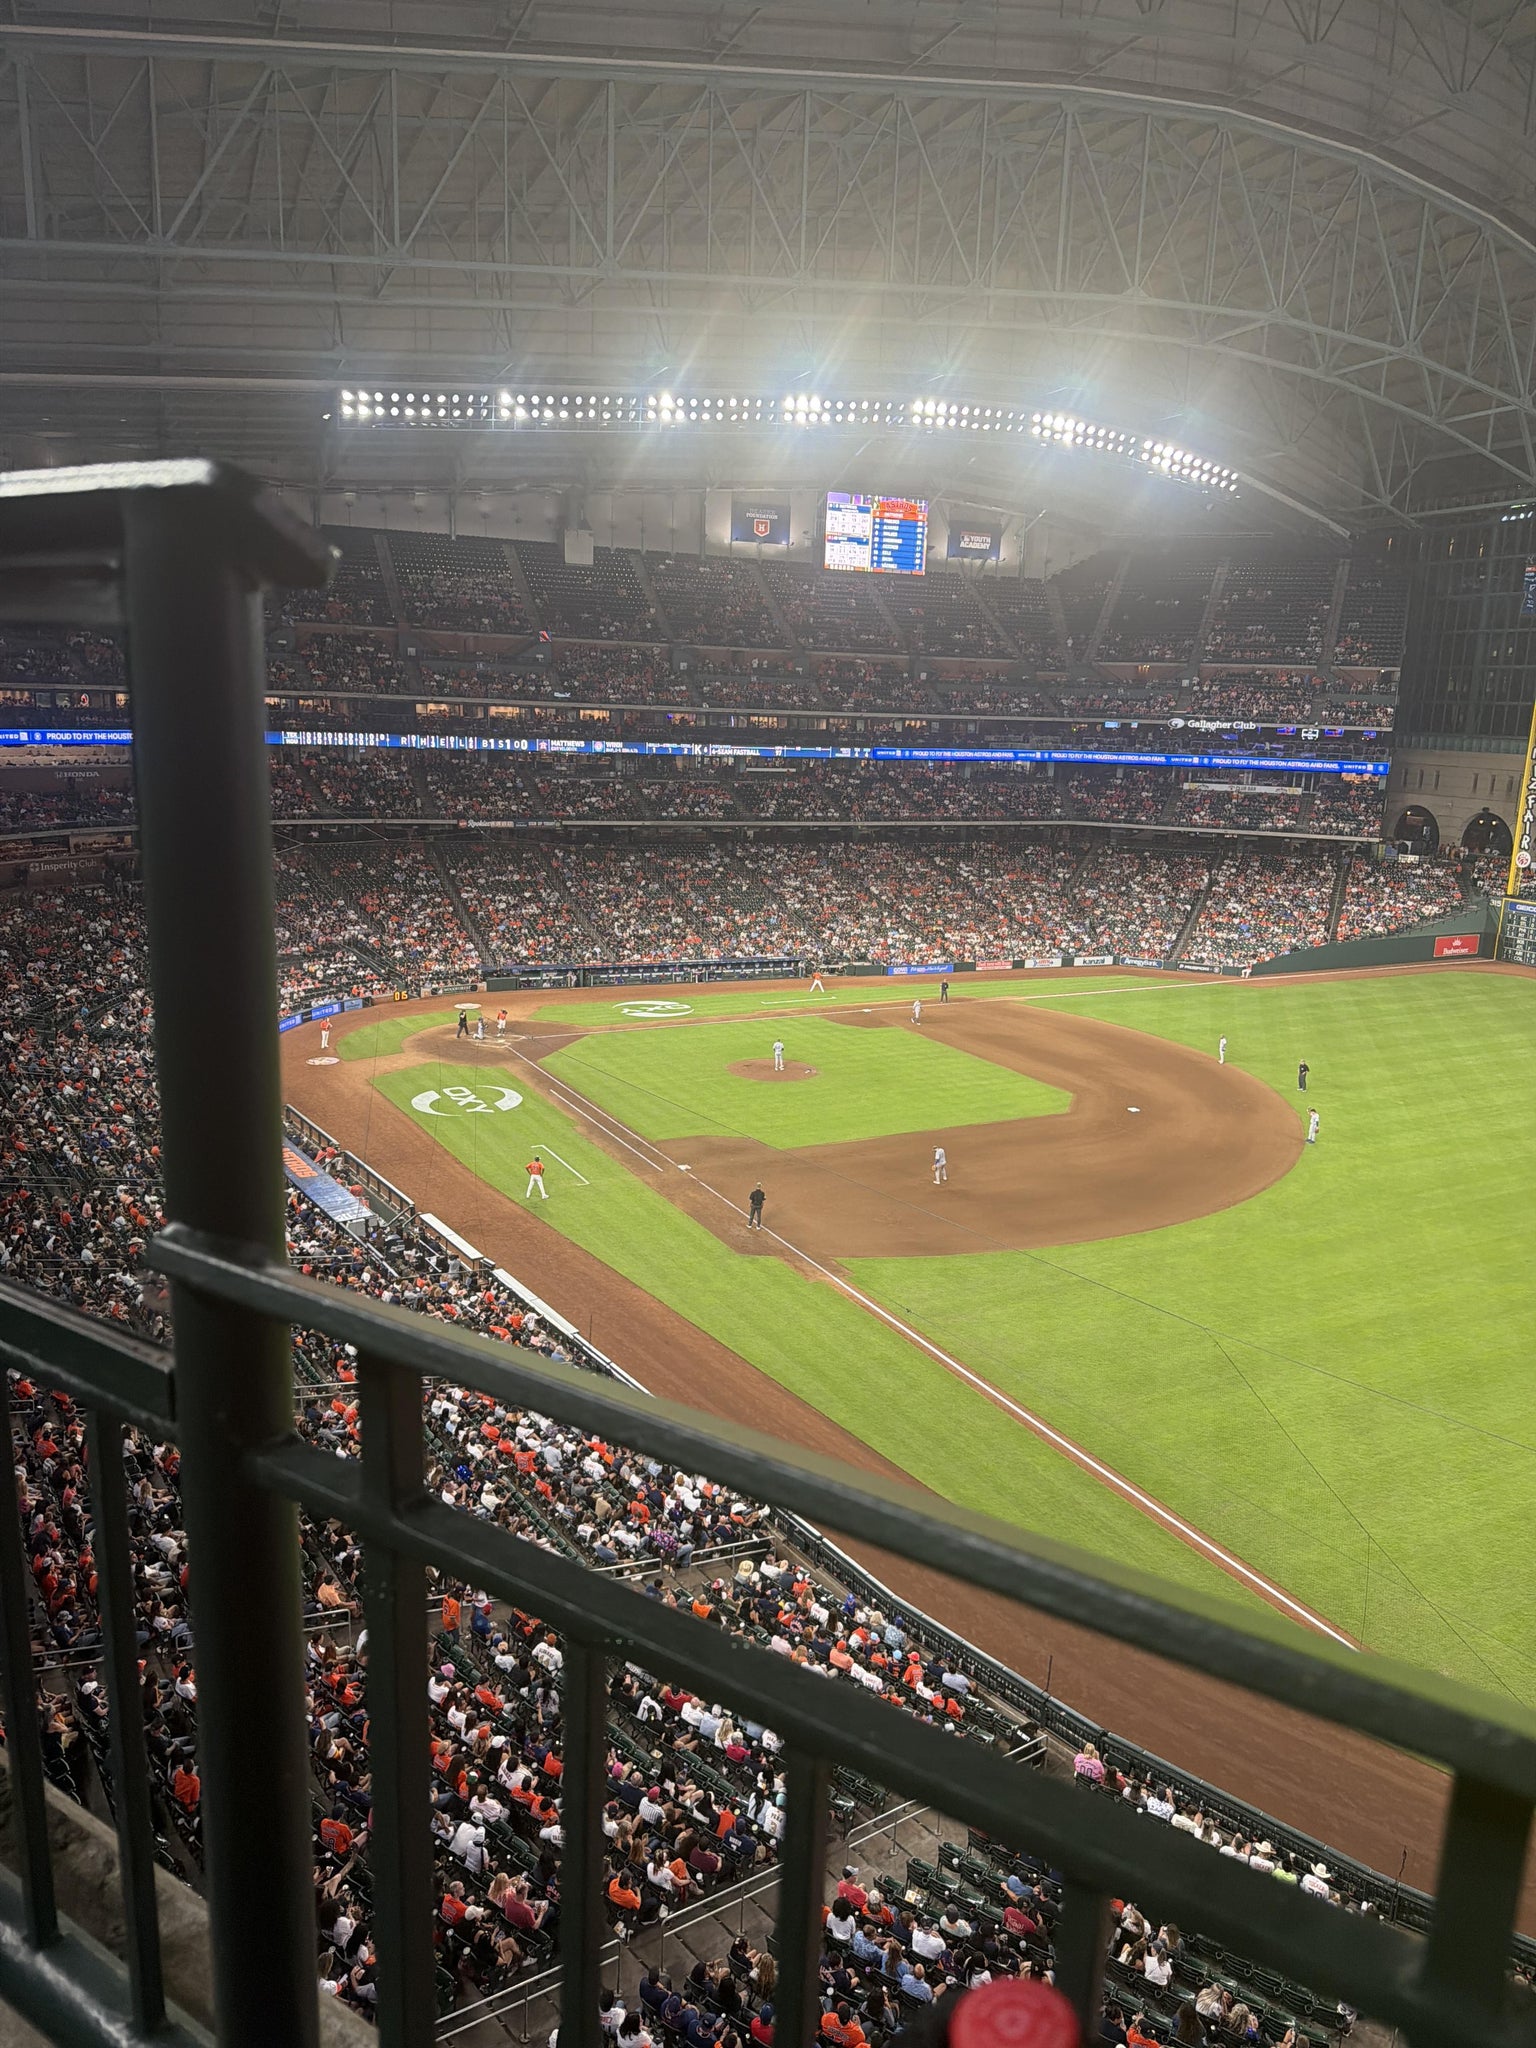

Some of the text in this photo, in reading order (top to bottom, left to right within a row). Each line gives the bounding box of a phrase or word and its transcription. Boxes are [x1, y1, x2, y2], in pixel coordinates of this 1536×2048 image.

[970, 535, 991, 543] YOUTH
[959, 541, 990, 550] ACADEMY
[1188, 719, 1256, 731] Gallagher Club
[46, 732, 72, 740] PROUD
[72, 732, 82, 740] TO
[82, 732, 94, 740] FLY
[94, 732, 107, 740] THE
[401, 737, 407, 745] R
[695, 744, 702, 754] K
[1521, 795, 1536, 850] FAIR
[41, 858, 97, 872] Insperity Club
[1489, 899, 1502, 908] 315
[1442, 947, 1469, 955] Budweiser
[312, 1006, 333, 1018] UNITED
[442, 1086, 495, 1113] OXY
